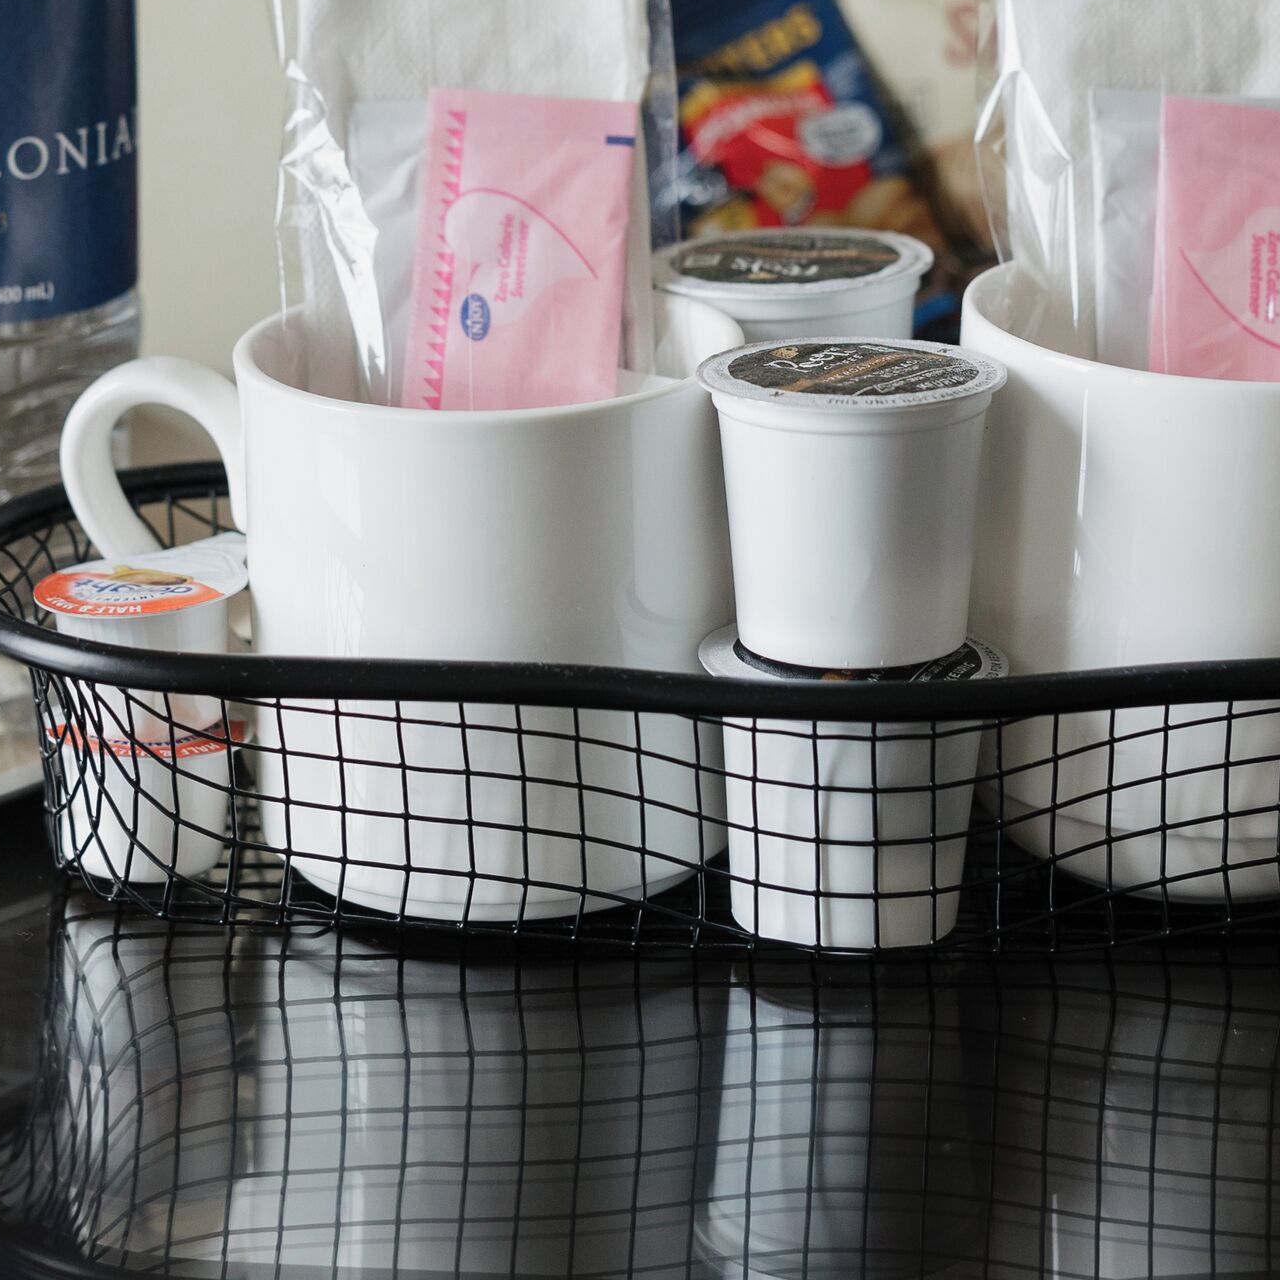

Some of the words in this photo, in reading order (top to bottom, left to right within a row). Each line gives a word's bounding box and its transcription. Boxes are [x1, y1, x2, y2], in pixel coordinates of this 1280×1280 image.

[497, 213, 516, 269] Calorie
[493, 272, 509, 304] Zero
[1249, 234, 1266, 320] Sweetener
[95, 604, 142, 616] HALF
[180, 742, 220, 756] HALF
